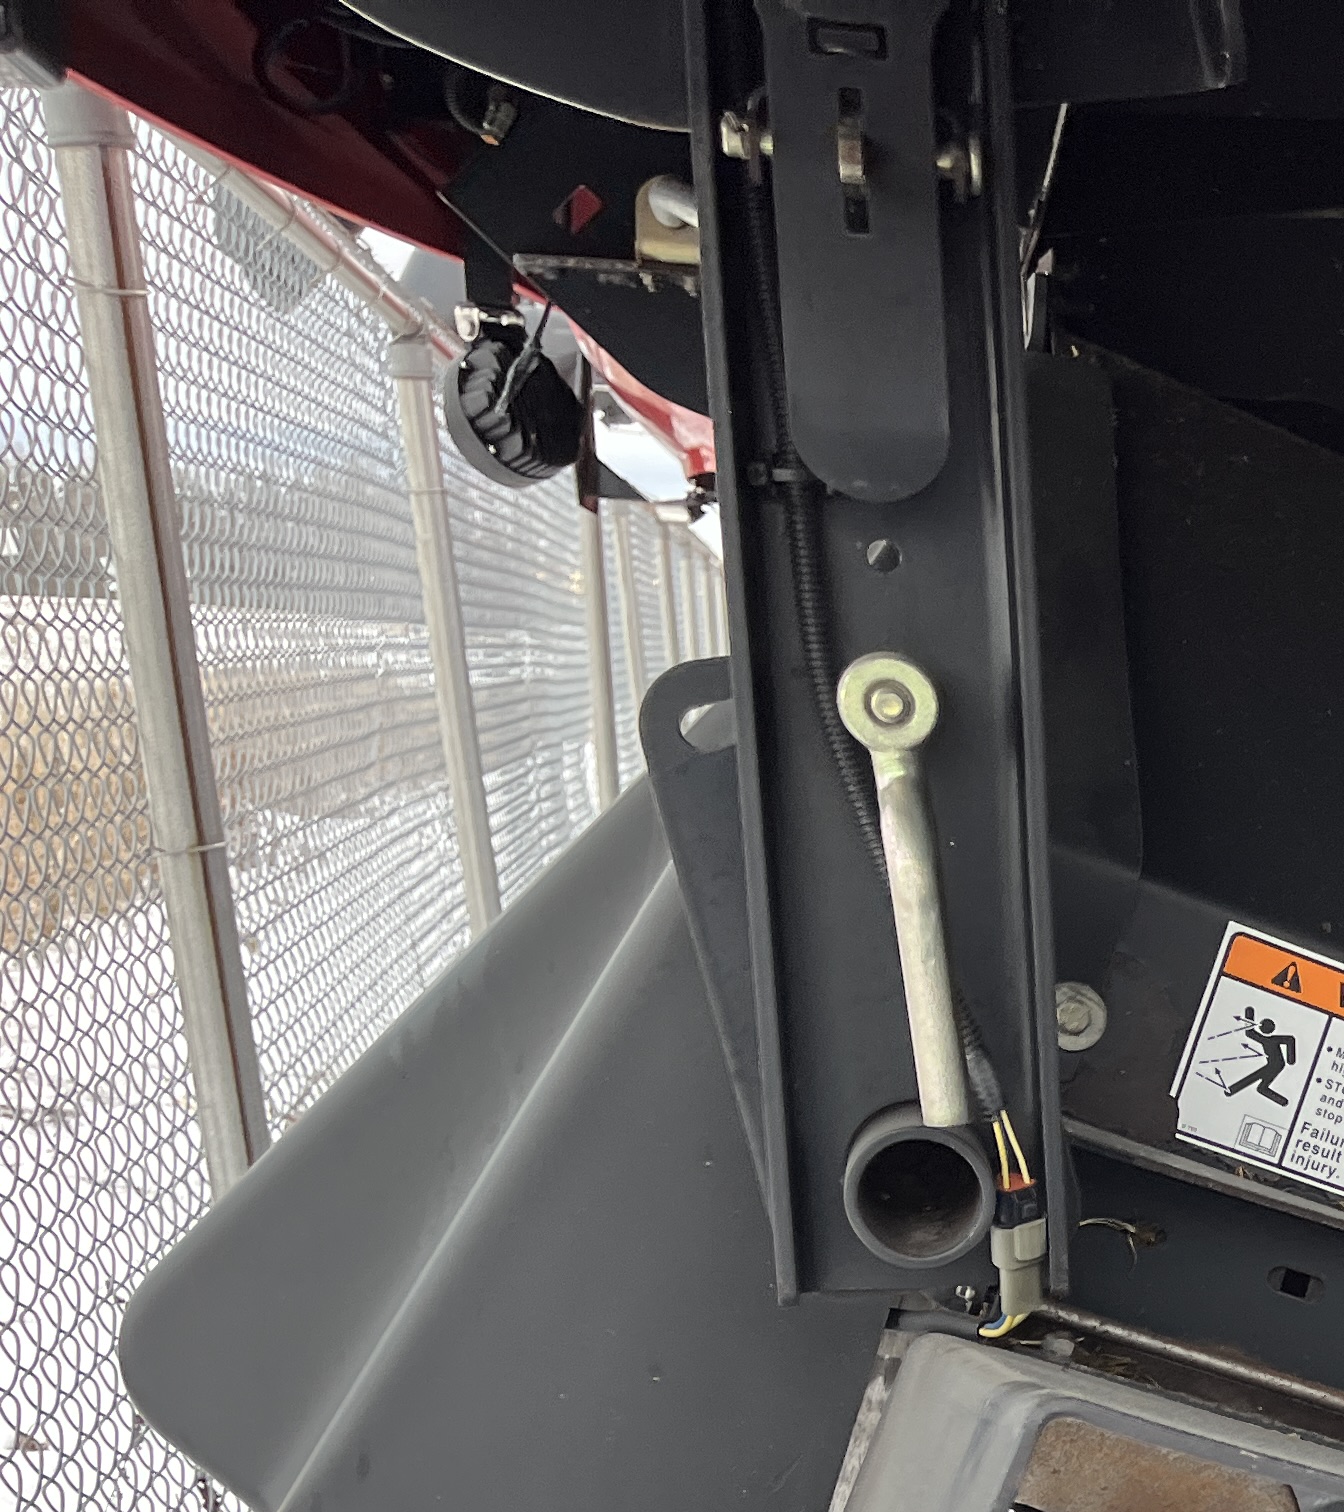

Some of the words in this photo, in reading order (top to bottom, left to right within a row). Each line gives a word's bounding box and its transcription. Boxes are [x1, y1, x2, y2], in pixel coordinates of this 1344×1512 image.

[1320, 1093, 1343, 1108] and
[1316, 1107, 1343, 1124] stop
[1295, 1139, 1342, 1163] result
